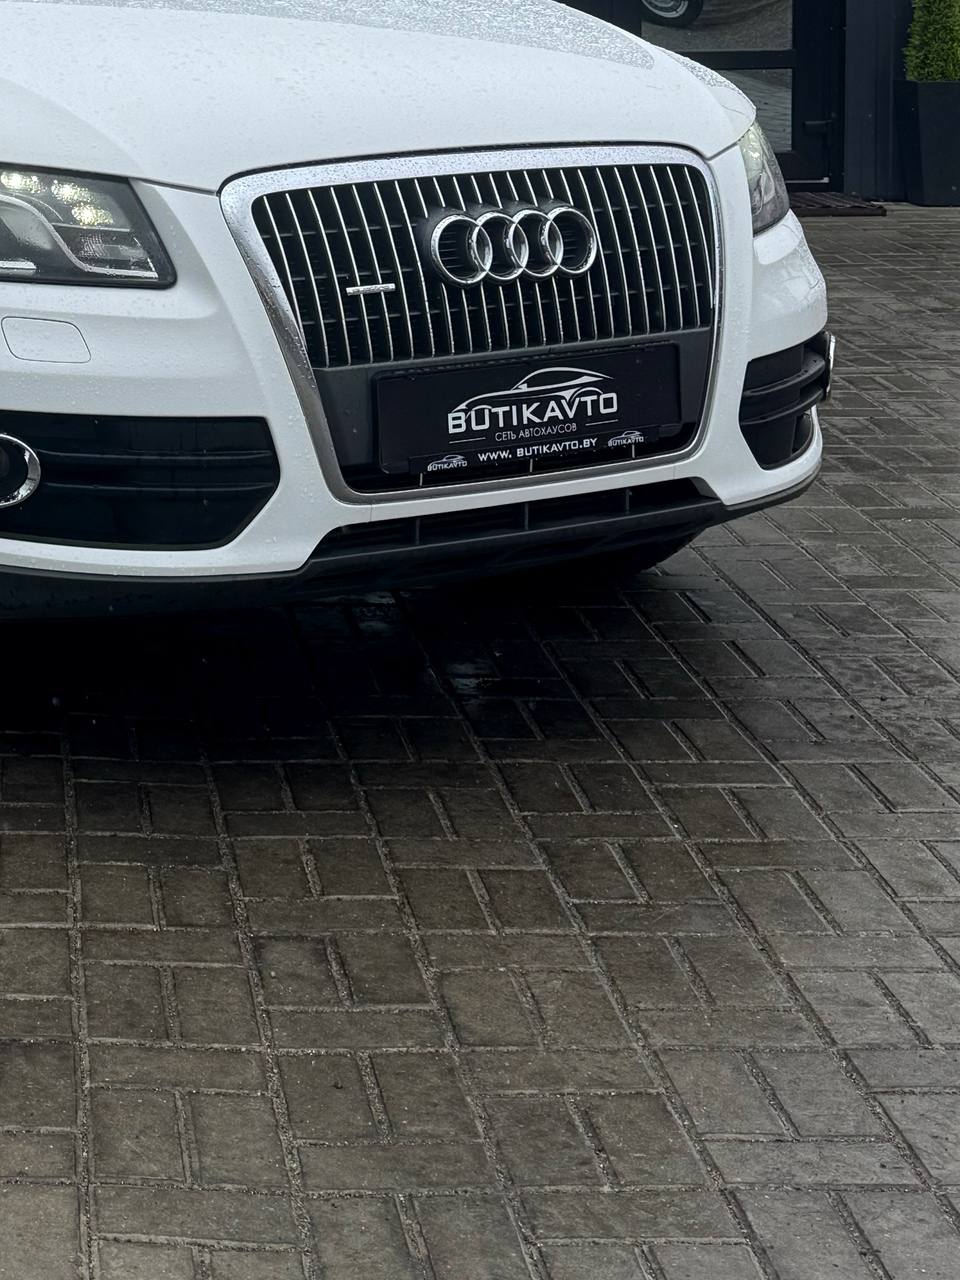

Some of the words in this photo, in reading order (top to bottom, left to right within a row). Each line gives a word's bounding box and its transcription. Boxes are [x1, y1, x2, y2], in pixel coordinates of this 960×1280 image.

[447, 391, 618, 434] BUTIKAVTO
[495, 431, 516, 441] СЕТЬ
[519, 423, 577, 439] АВТОХАУСОВ
[478, 449, 512, 462] WWW.
[516, 438, 598, 458] BUTIKAVTO.BY
[607, 436, 644, 448] BUTIKAVTO
[427, 460, 468, 472] BUTIKAVTO
